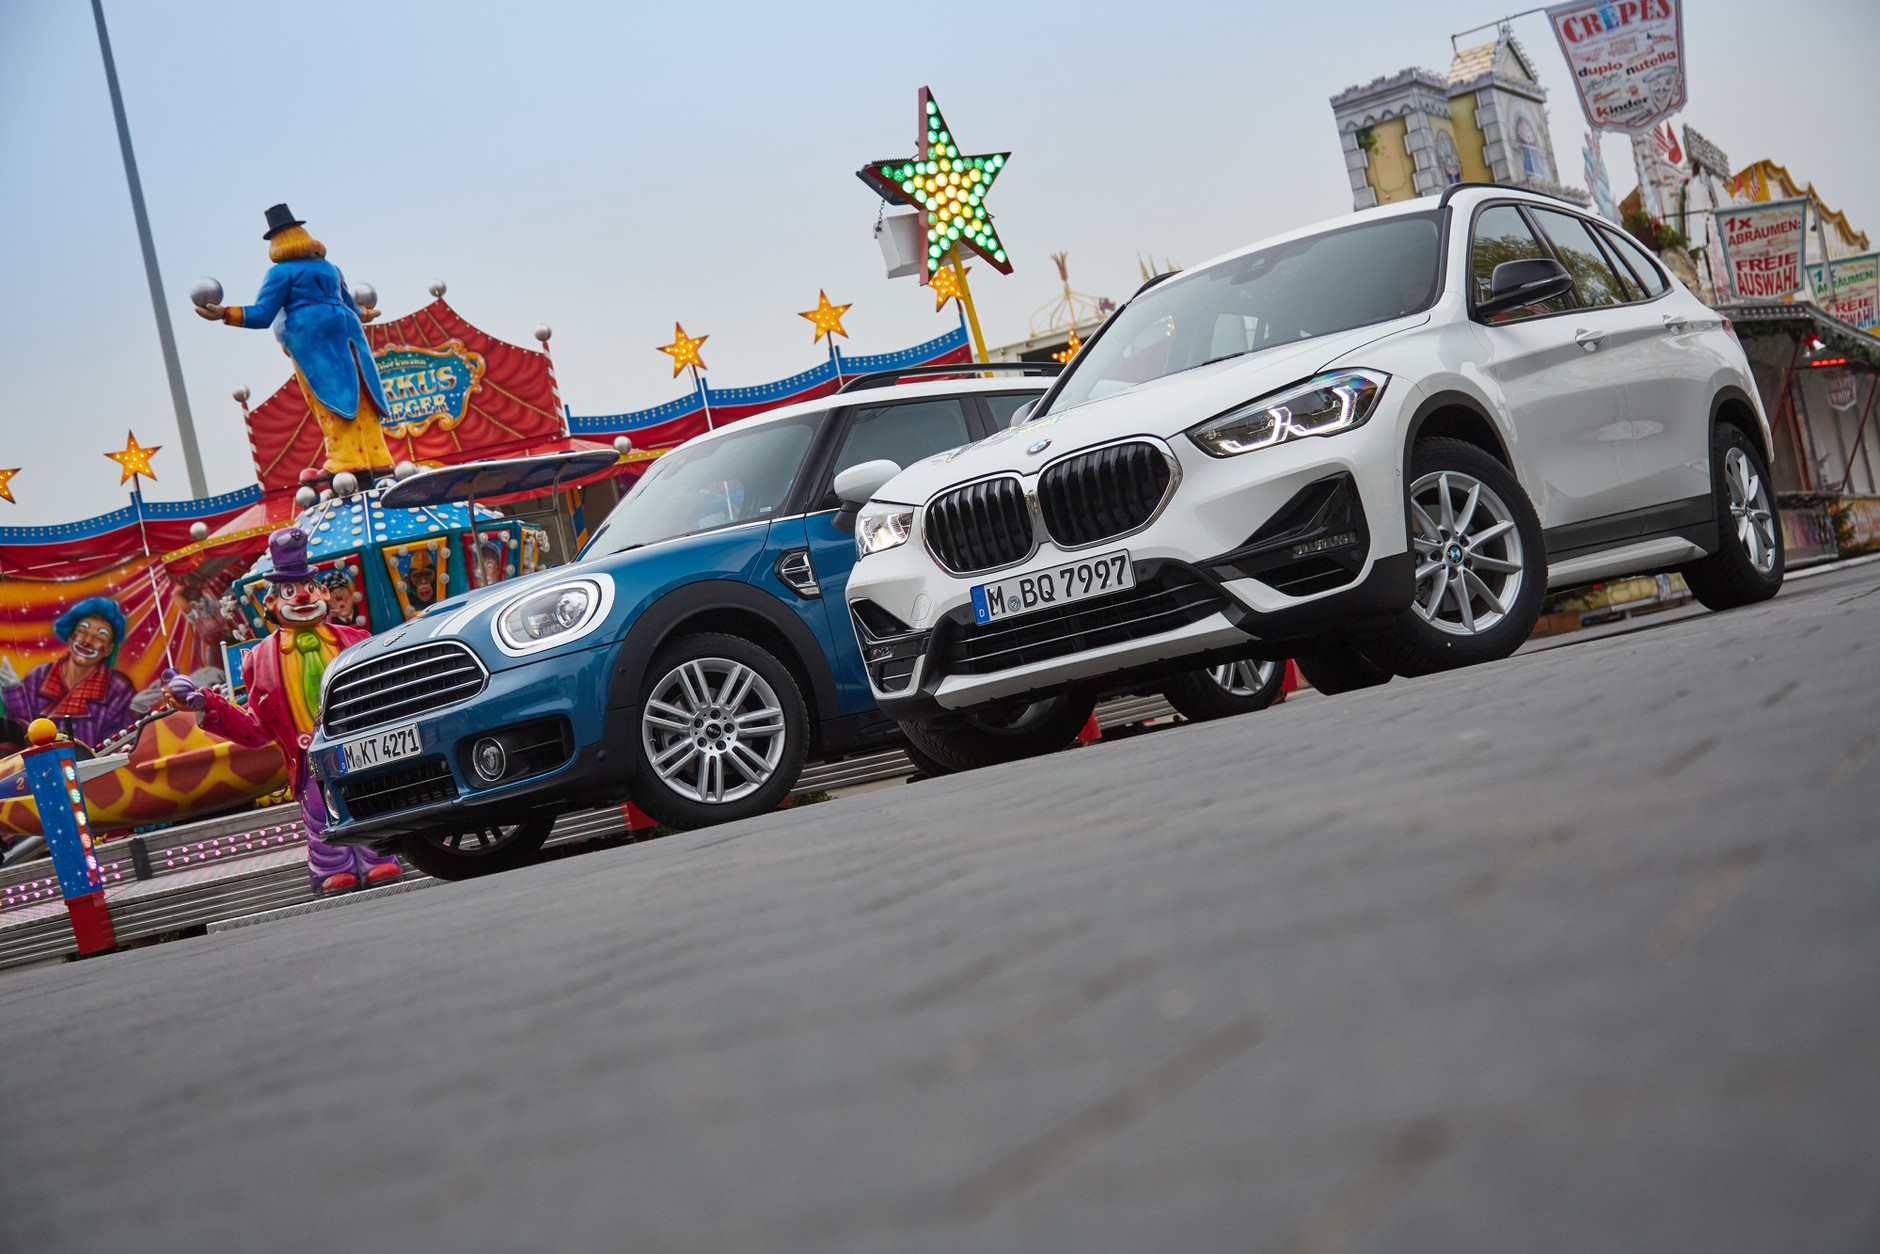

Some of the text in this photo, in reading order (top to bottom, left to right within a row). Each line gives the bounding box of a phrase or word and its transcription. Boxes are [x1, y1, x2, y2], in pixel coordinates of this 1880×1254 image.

[1578, 61, 1623, 77] duplo
[1625, 50, 1677, 76] nutella
[1595, 96, 1648, 118] kinder
[1727, 219, 1801, 247] ABRÄUMEN:
[1736, 253, 1798, 271] FREIE
[1737, 266, 1800, 297] AUSWAHL
[381, 366, 457, 401] RKUS
[978, 555, 1126, 618] D M BQ 7997
[344, 745, 356, 769] M
[360, 738, 378, 765] KT
[383, 728, 419, 758] 4271
[16, 776, 25, 791] 2
